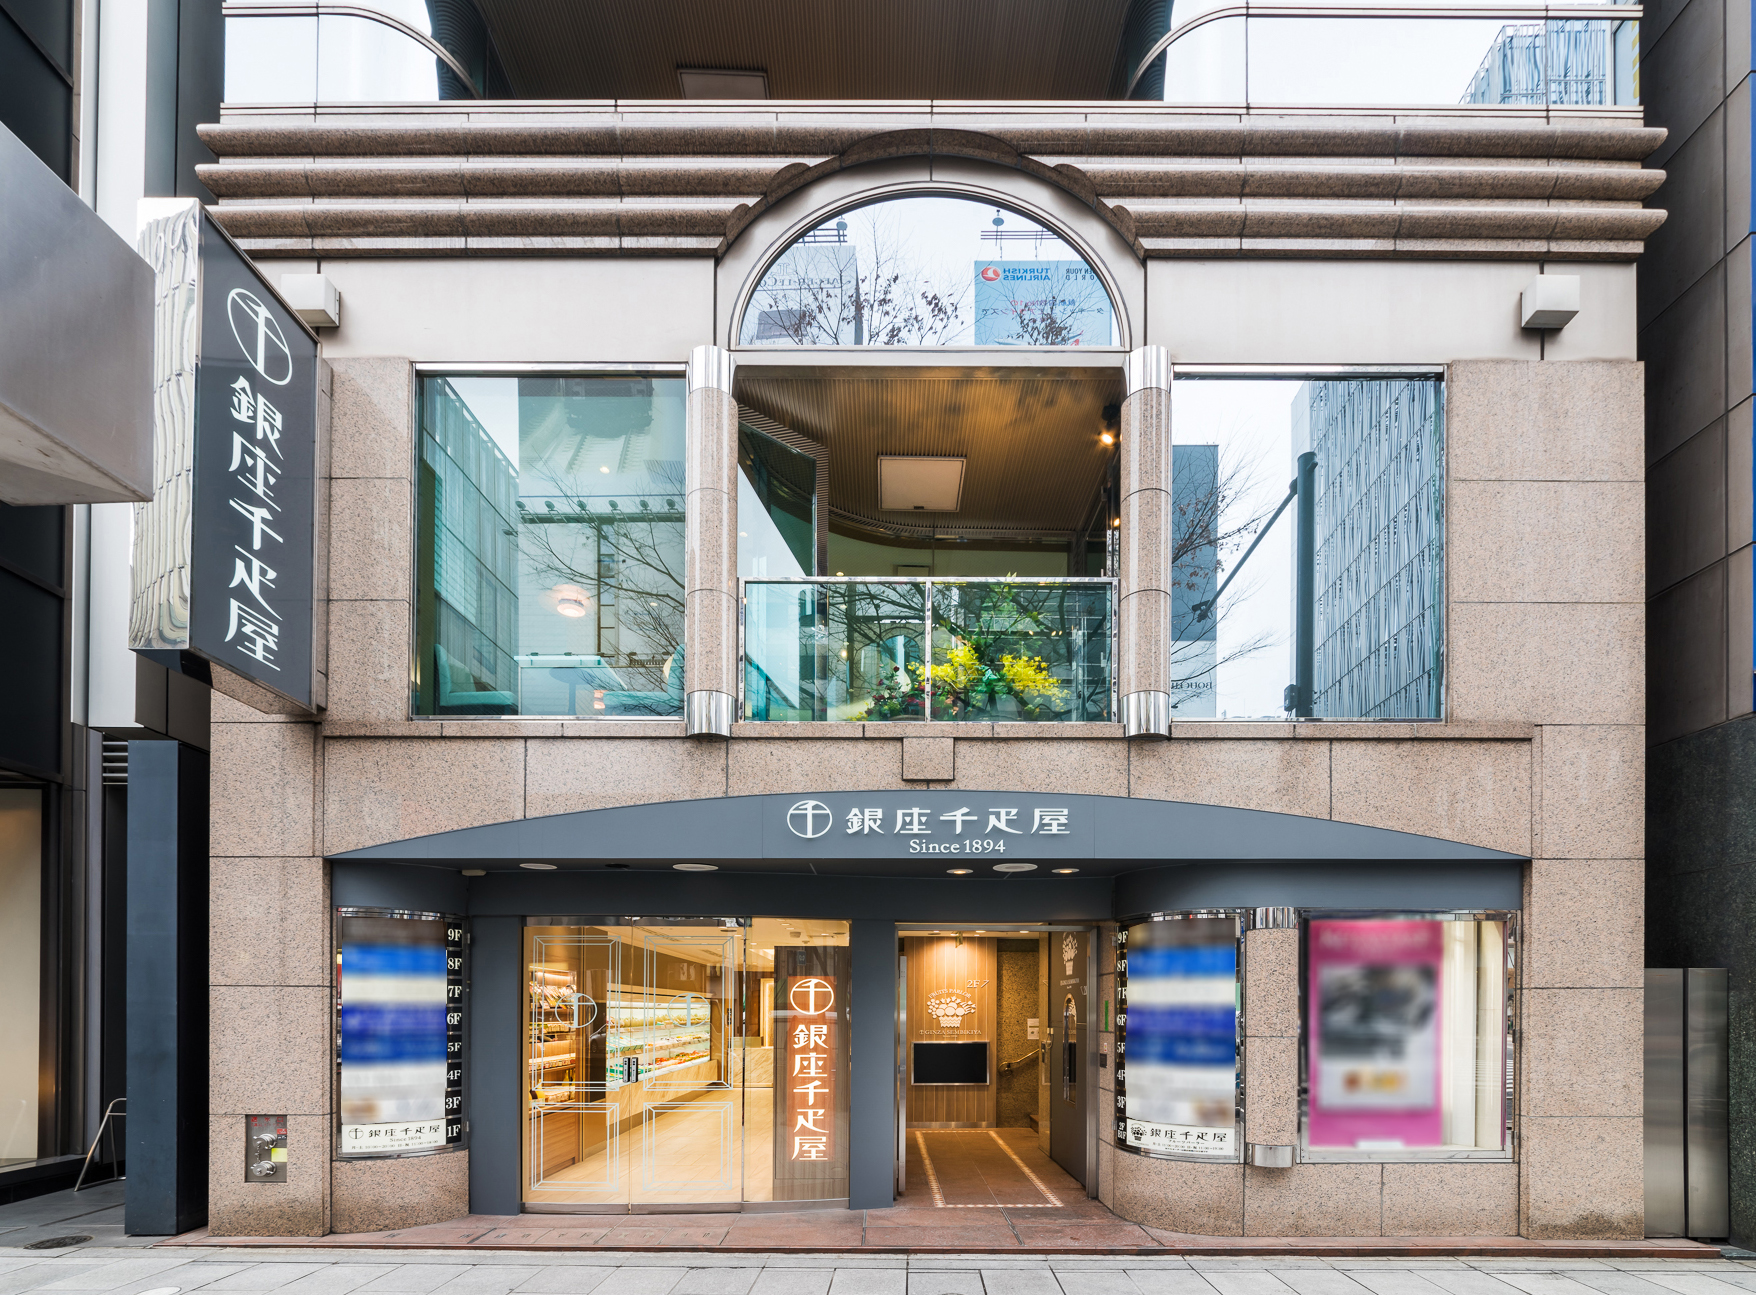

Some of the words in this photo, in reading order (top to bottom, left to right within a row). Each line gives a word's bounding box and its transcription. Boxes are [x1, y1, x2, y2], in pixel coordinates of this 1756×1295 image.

[224, 374, 285, 672] 銀座千疋屋
[845, 806, 1070, 834] 銀座千疋屋
[909, 839, 960, 854] Since
[964, 839, 1006, 854] 1894
[448, 929, 462, 941] 9F
[1118, 931, 1128, 943] 9F
[448, 958, 462, 970] 8F
[1117, 959, 1127, 972] 8F
[967, 980, 980, 988] 2F
[448, 986, 462, 998] 7F
[928, 988, 948, 998] FRUITS
[949, 988, 972, 998] PARLOR
[447, 1013, 462, 1025] 6F
[1117, 1014, 1126, 1026] 6F
[447, 1042, 462, 1052] 5F
[1117, 1042, 1126, 1053] 5F
[447, 1070, 461, 1080] 4F
[791, 1024, 829, 1161] 銀座千疋屋
[446, 1097, 461, 1109] 3F
[1117, 1096, 1126, 1108] 3F
[368, 1125, 441, 1138] 銀座千疋屋
[447, 1125, 461, 1138] 1F
[1150, 1128, 1227, 1142] 銀座千疋屋
